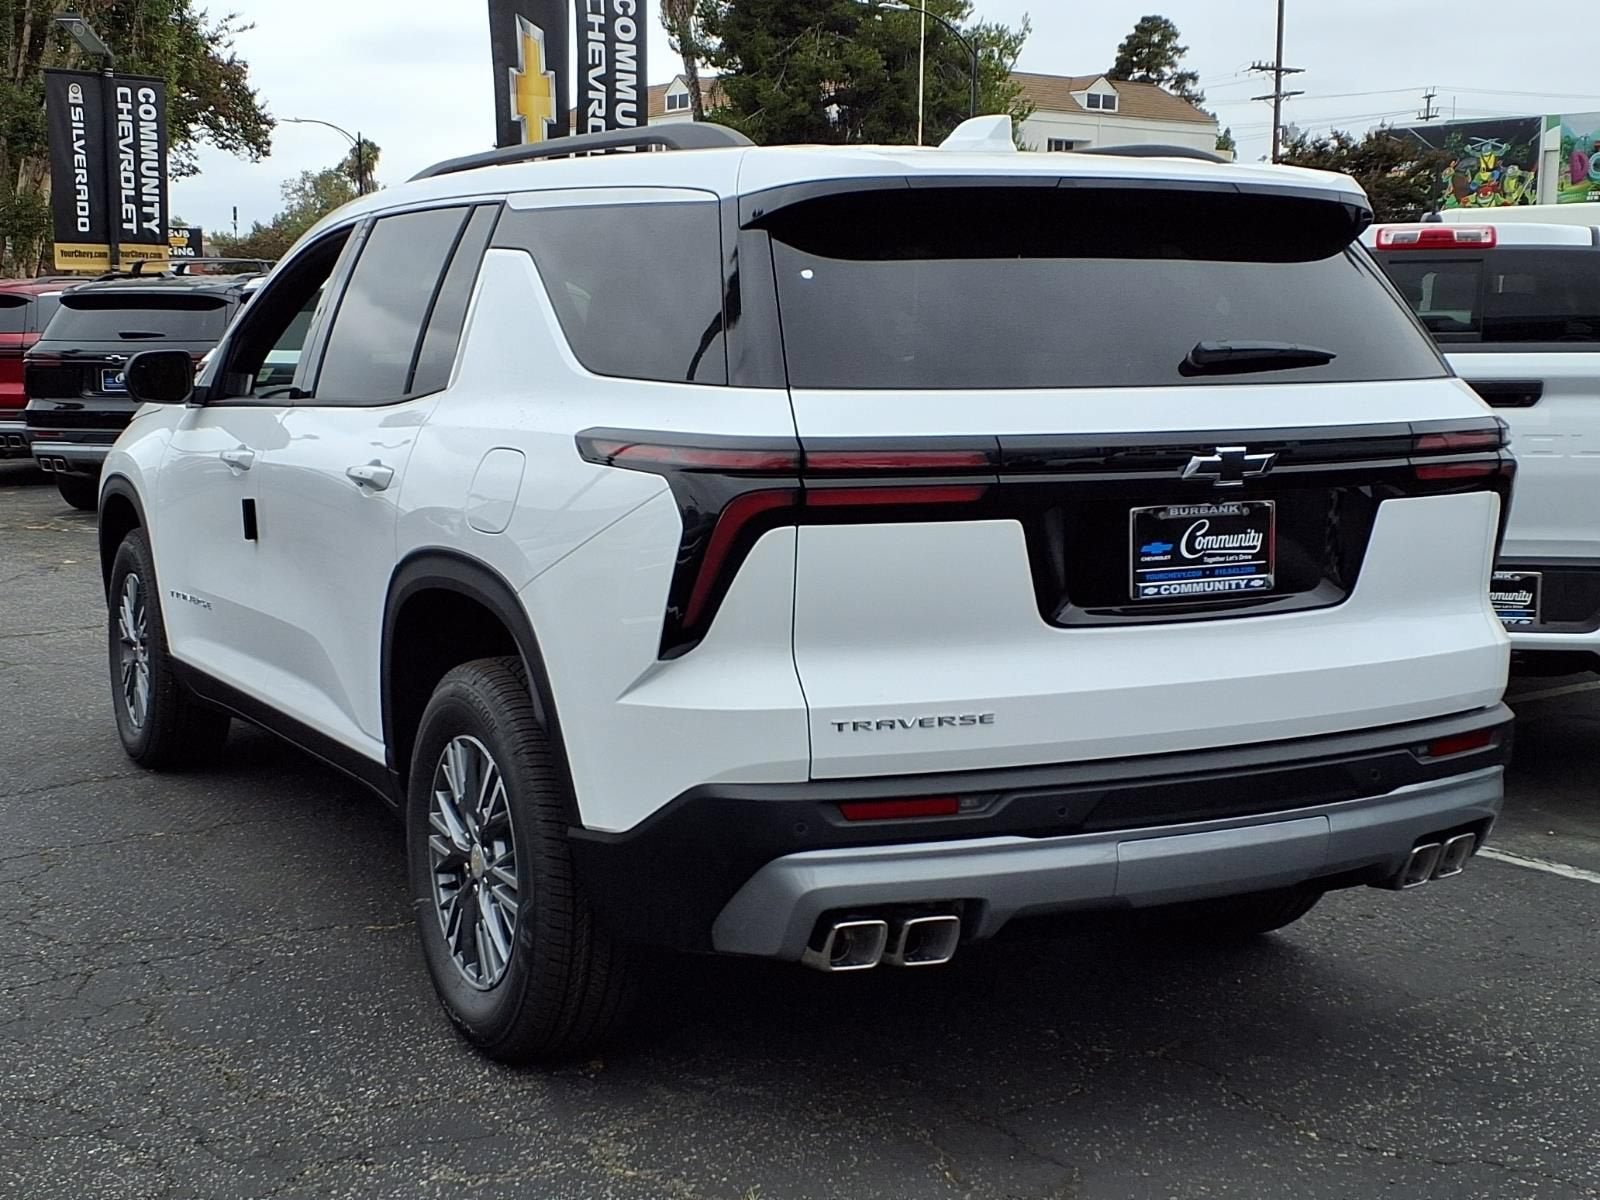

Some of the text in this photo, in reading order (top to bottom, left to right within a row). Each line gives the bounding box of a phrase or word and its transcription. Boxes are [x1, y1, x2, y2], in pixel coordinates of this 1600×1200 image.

[116, 86, 137, 235] CHEVROLET
[137, 87, 162, 234] COMMUNITY
[70, 106, 90, 233] SILVERADO
[168, 228, 190, 238] SUB
[60, 249, 108, 259] YourChevy.com
[120, 250, 163, 259] ourChevy.com
[1169, 504, 1239, 516] BURBANK
[1180, 519, 1263, 559] Community
[1160, 580, 1248, 595] COMMUNITY
[831, 713, 995, 733] TRAVERSE
